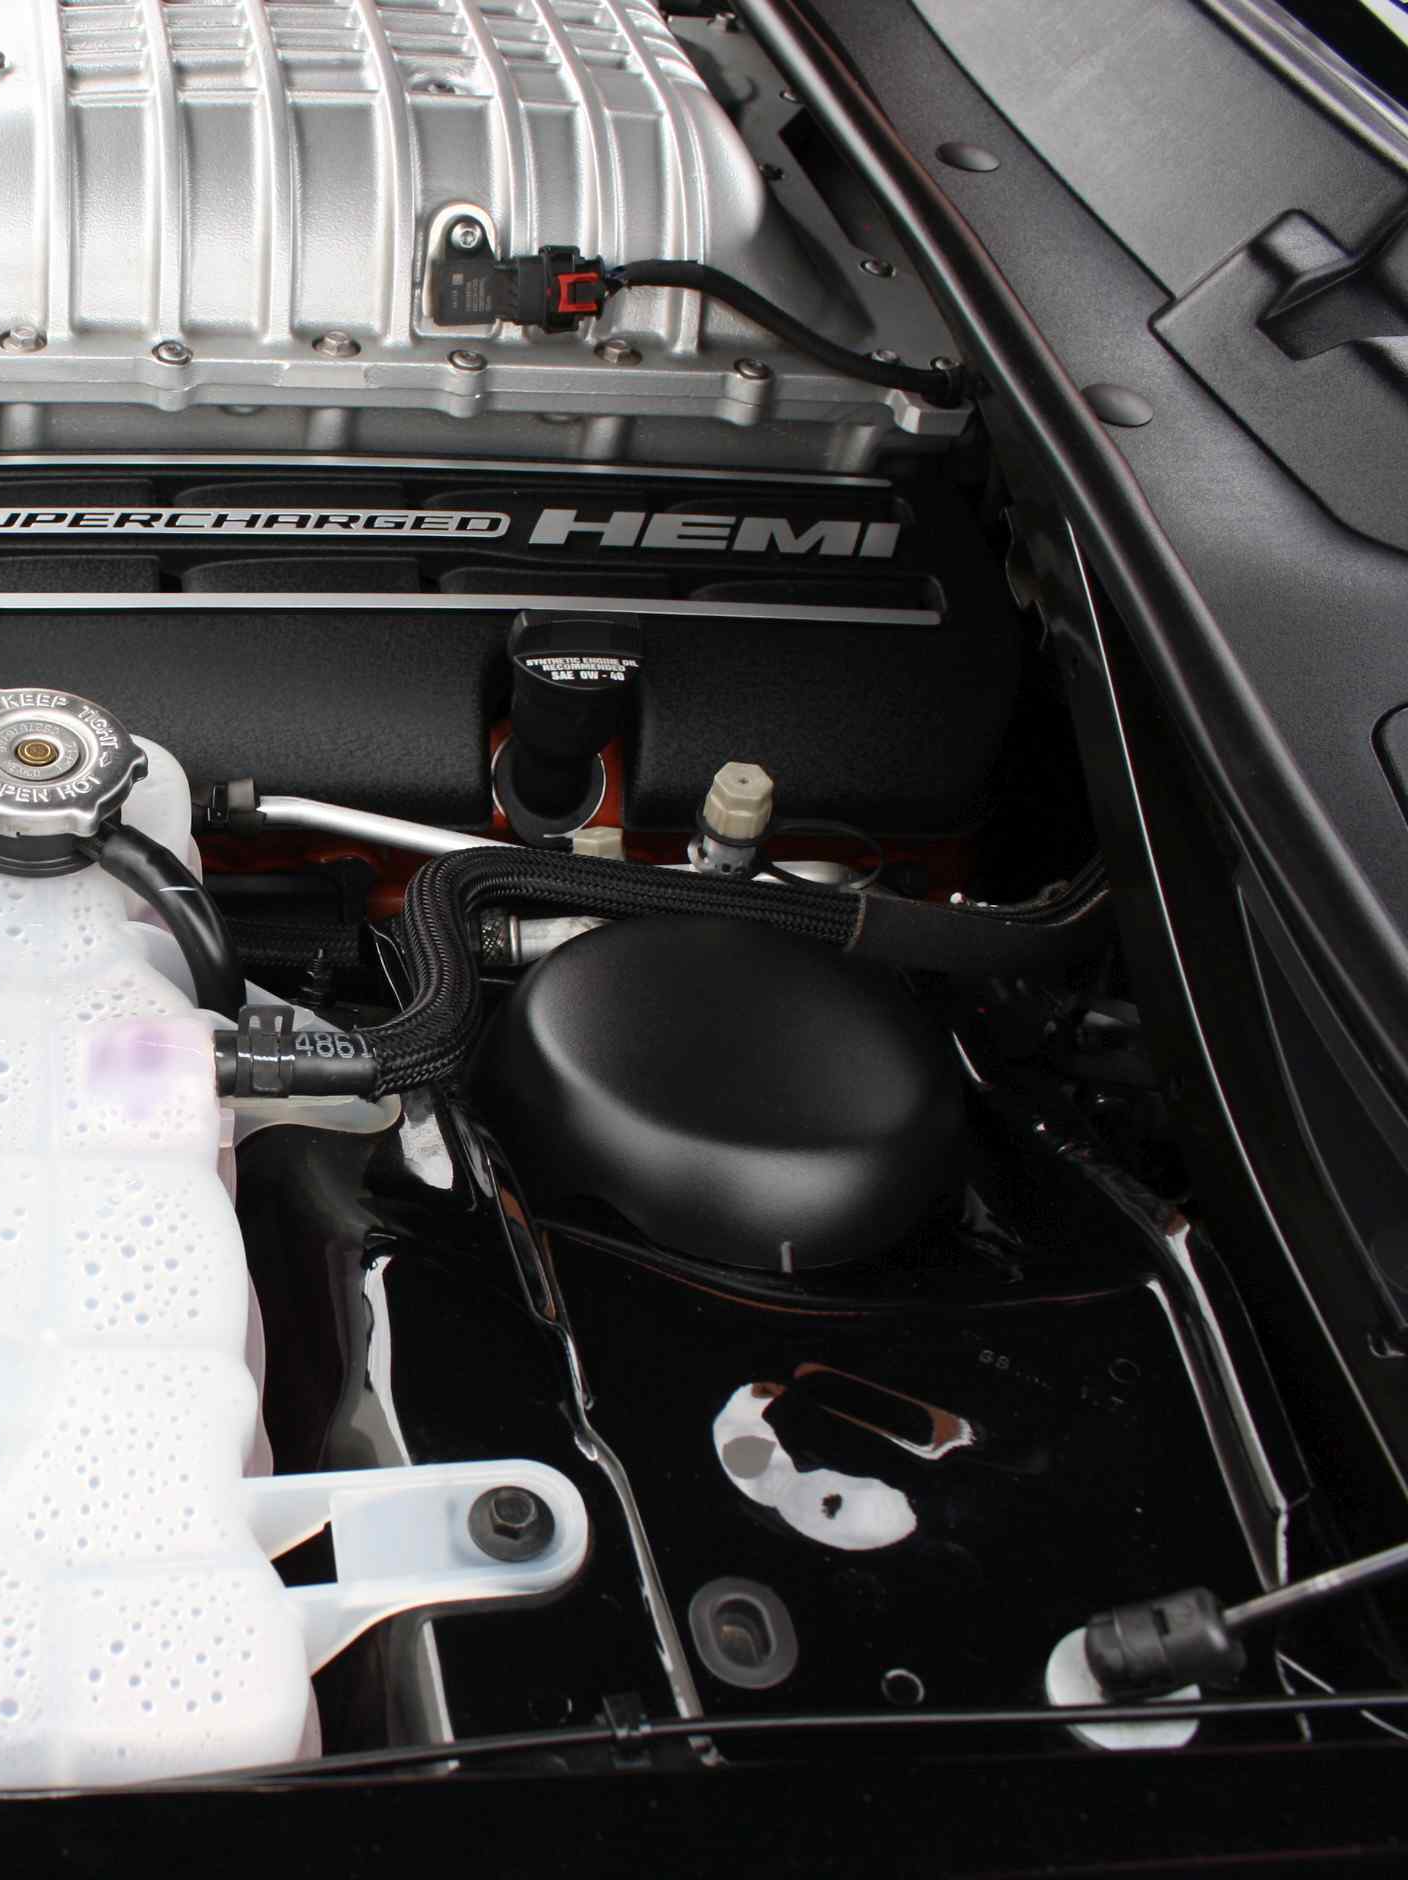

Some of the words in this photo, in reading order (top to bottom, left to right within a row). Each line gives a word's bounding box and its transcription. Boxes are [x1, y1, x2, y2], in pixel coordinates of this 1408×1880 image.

[528, 508, 901, 557] HEMI
[525, 657, 580, 665] SYNTHETIC
[582, 657, 619, 666] ENGINE
[621, 659, 639, 667] OIL
[542, 664, 626, 672] RECOMMENDED
[551, 671, 575, 680] SAE
[0, 693, 70, 709] KEEP
[77, 705, 119, 750] TIGHT
[57, 774, 101, 799] HOT
